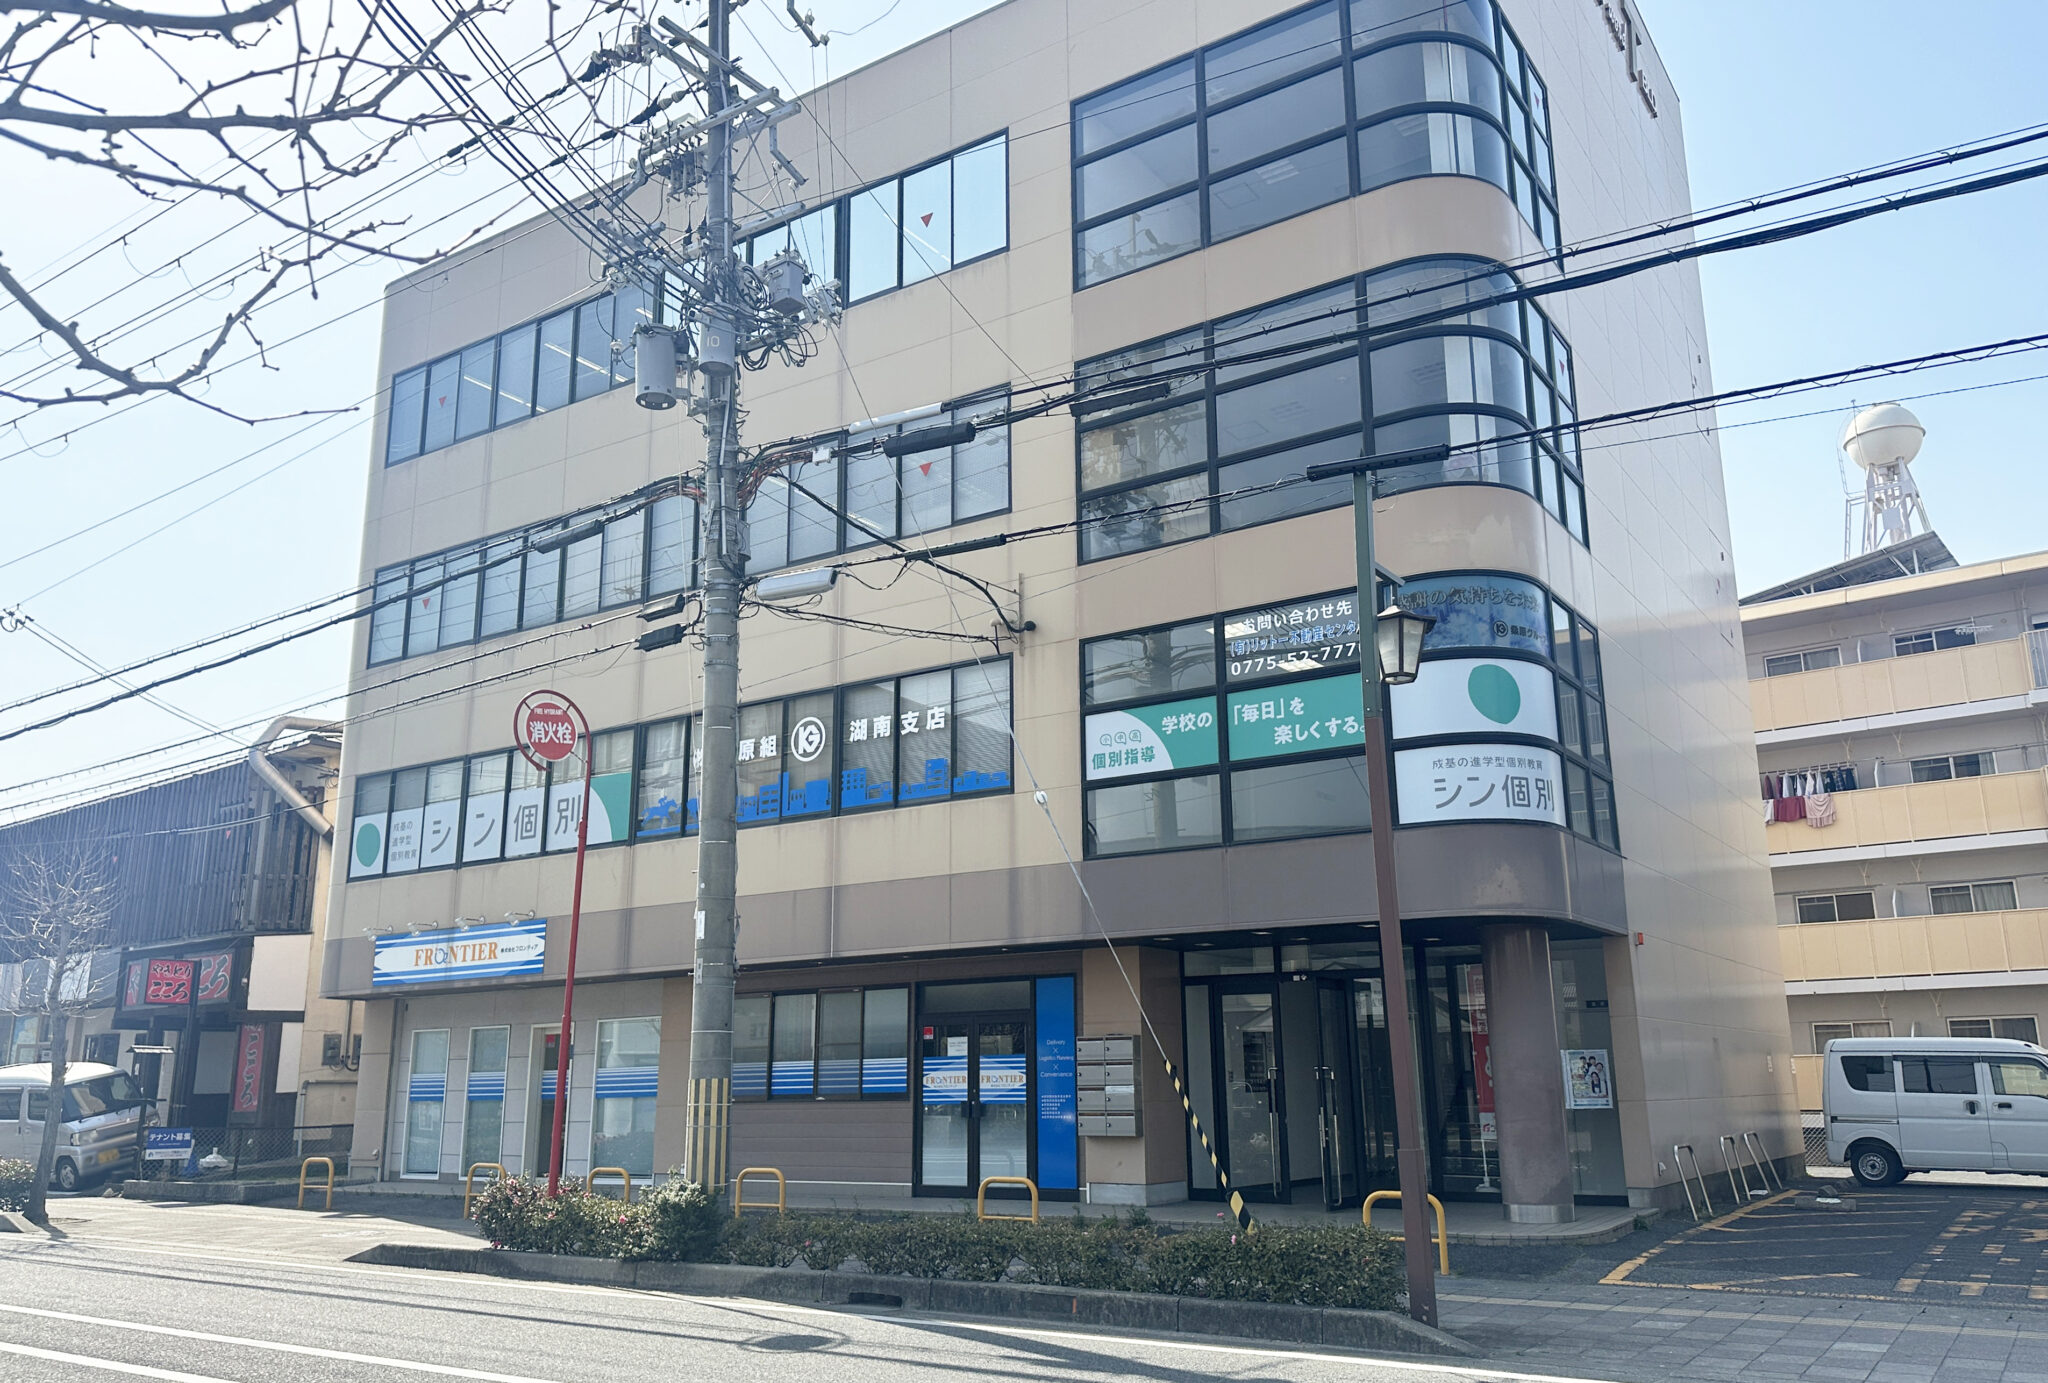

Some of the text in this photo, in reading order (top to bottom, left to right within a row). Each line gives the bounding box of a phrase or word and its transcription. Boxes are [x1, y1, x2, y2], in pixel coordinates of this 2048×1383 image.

[706, 335, 720, 348] 10
[1243, 600, 1352, 632] お問い合わせ先
[1230, 619, 1360, 657] (有)リットー不動産センタ
[1230, 642, 1362, 676] 0775-52-777
[849, 706, 946, 744] 湖南支店
[1161, 696, 1305, 735] 学校の 「毎日」を
[529, 720, 573, 744] 消火栓
[1274, 715, 1366, 746] 楽しくする。
[1091, 745, 1156, 771] 個別指導
[1432, 755, 1544, 771] 成基の進学型個別教育
[1434, 774, 1556, 812] シン個別
[431, 794, 582, 854] シン個別
[414, 941, 498, 967] FRONTIER
[152, 963, 192, 979] やきとり
[148, 980, 189, 1001] こころ
[149, 1132, 191, 1142] テナント募集
